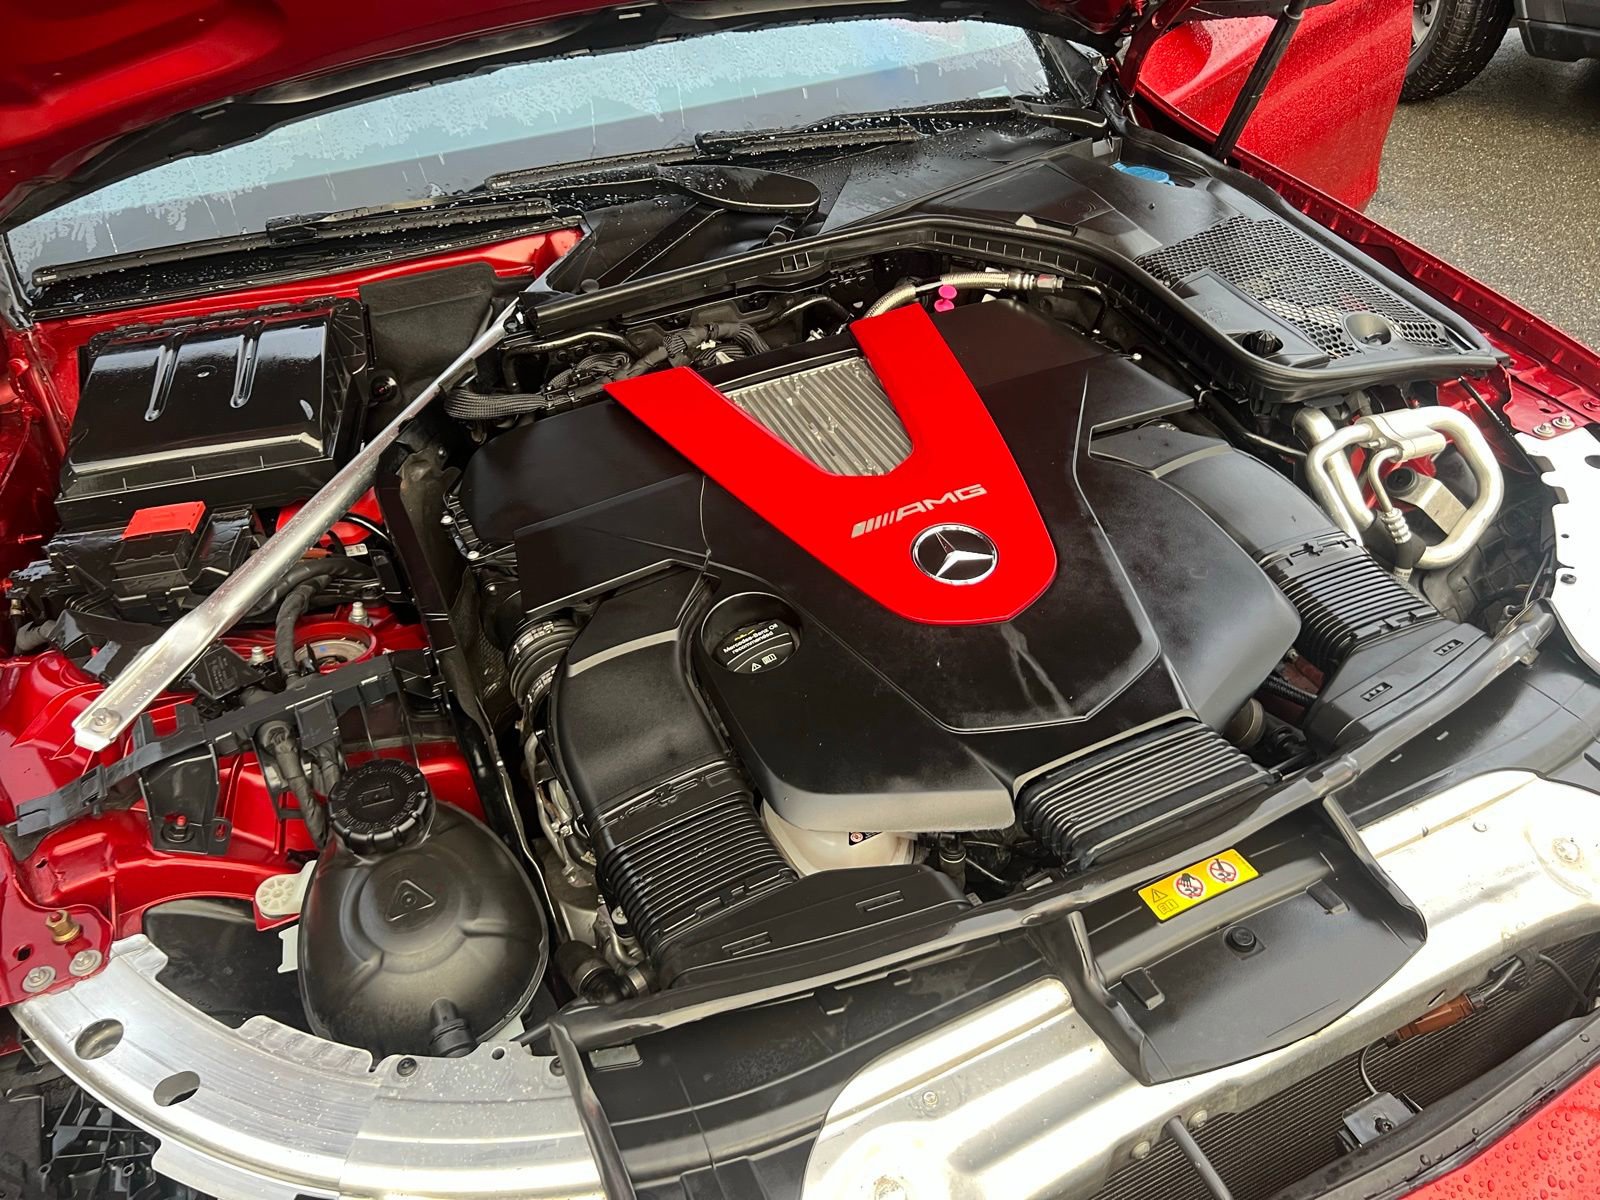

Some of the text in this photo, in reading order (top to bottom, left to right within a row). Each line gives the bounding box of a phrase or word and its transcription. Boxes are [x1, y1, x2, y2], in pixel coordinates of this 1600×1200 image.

[896, 484, 988, 522] AMG
[723, 628, 769, 653] Mercedes-Benz
[732, 631, 774, 654] recommended
